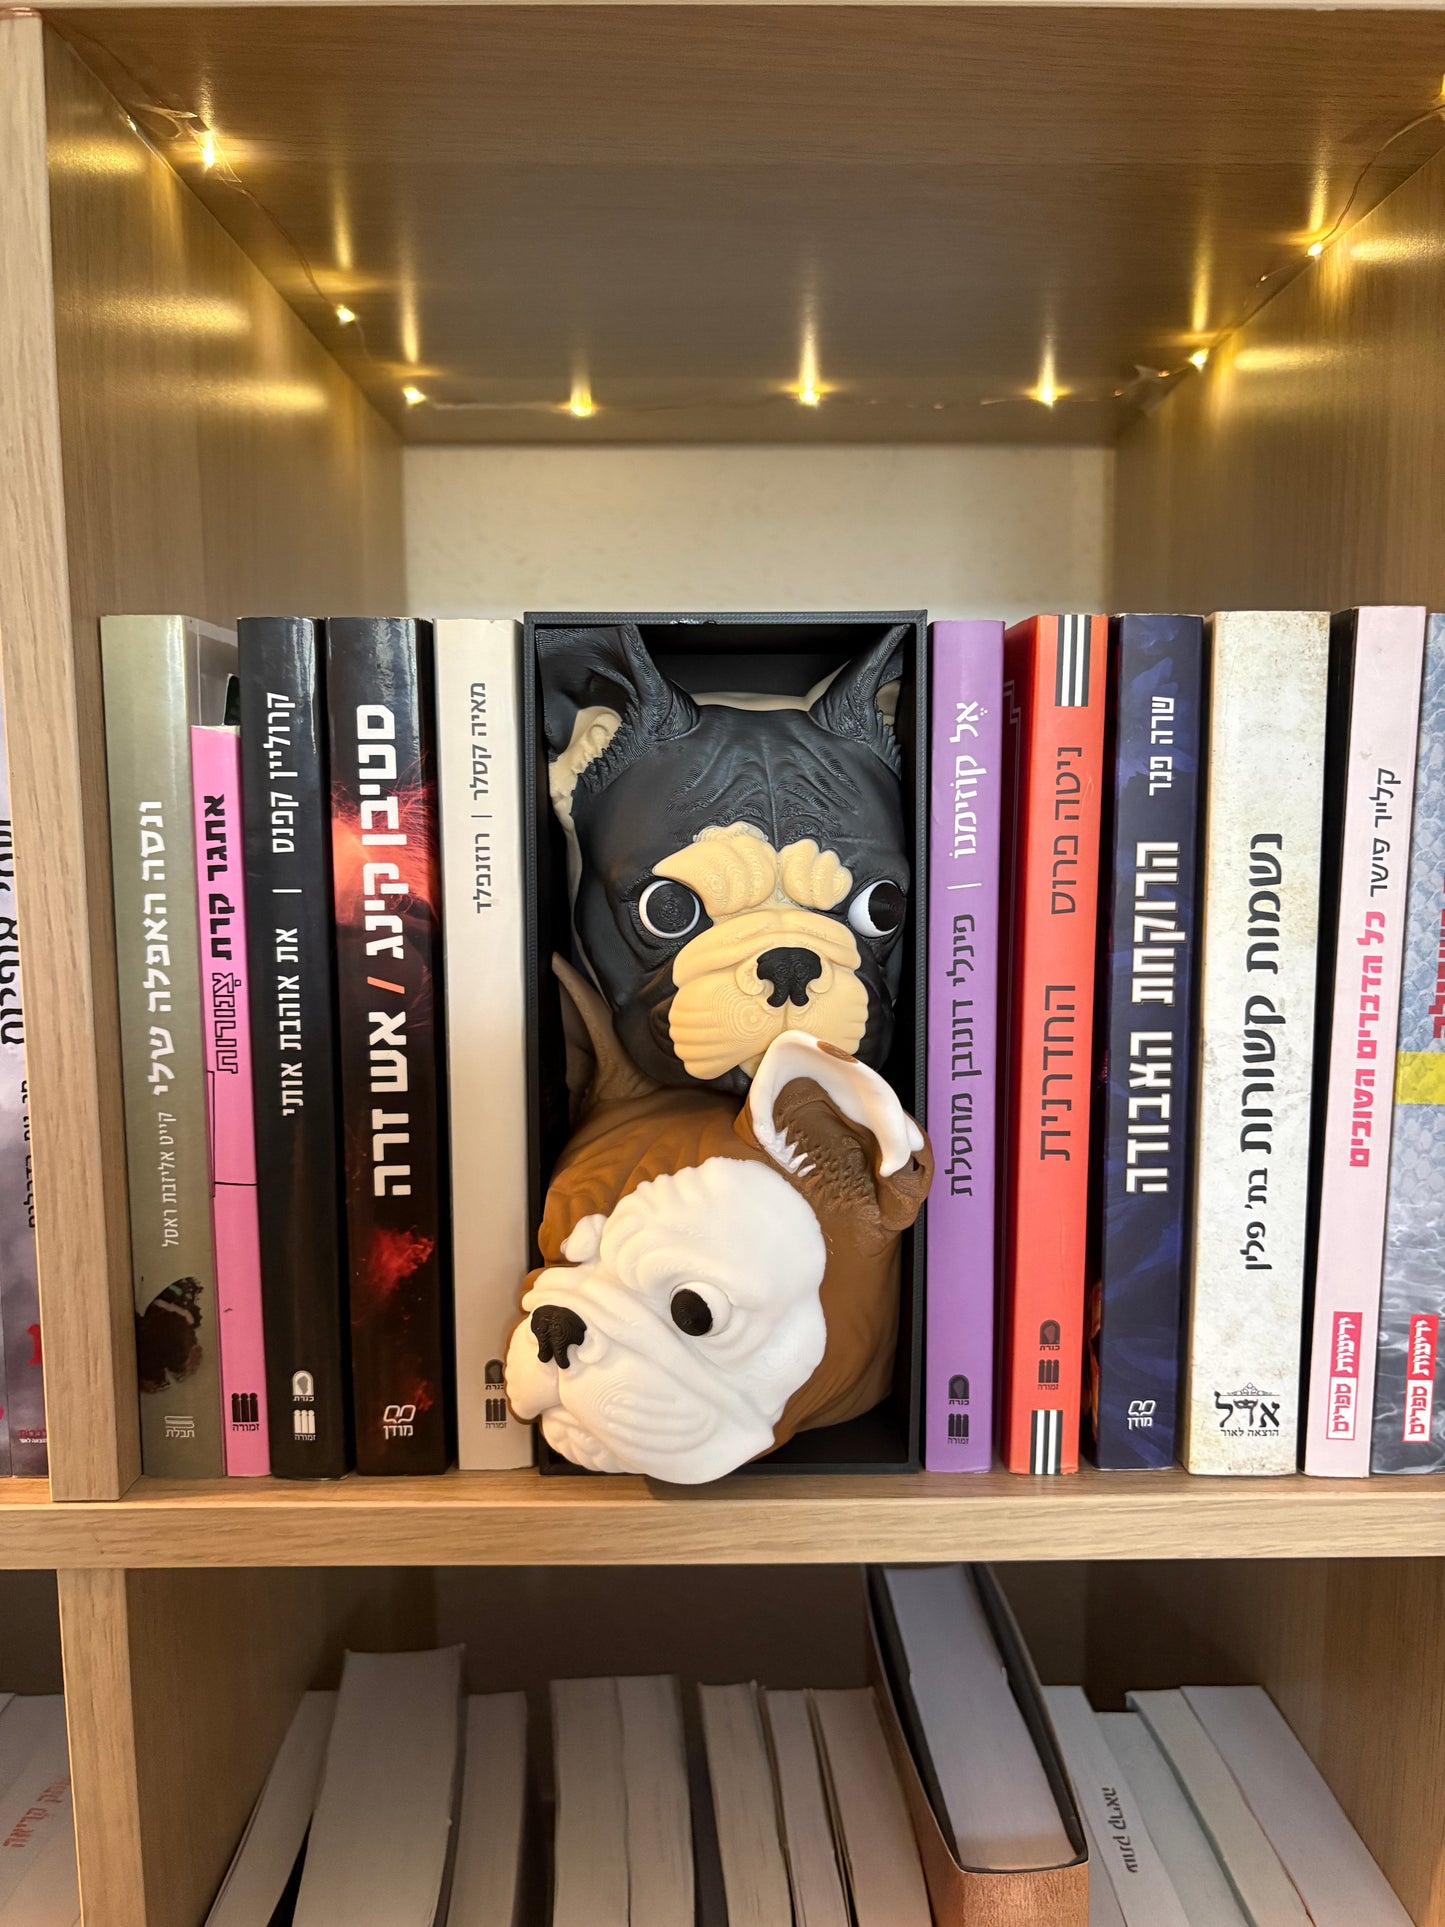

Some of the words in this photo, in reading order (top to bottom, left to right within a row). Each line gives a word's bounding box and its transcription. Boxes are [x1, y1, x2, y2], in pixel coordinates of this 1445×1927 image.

[263, 692, 298, 780] קרוליין
[470, 682, 487, 737] מאיה
[1150, 696, 1175, 745] שרה
[355, 704, 408, 847] סטיבן
[469, 743, 492, 801] קסלר
[1054, 746, 1083, 821] ניטה
[1148, 756, 1173, 796] פנר
[1369, 767, 1402, 829] קלייר
[139, 801, 166, 882] ונסה
[203, 794, 228, 882] אתגר
[270, 791, 299, 853] קפנס
[472, 833, 492, 914] רוזנפלד
[1051, 835, 1079, 915] פרוס
[1370, 837, 1391, 898] פישר
[208, 893, 235, 961] קרת
[361, 860, 410, 960] קינג
[1131, 842, 1186, 1004] הרוקחת
[1246, 833, 1283, 975] נשמות
[1356, 911, 1386, 946] כל
[142, 893, 172, 1013] האפלה
[275, 928, 299, 963] את
[945, 914, 975, 986] פינלי
[277, 975, 302, 1051] אוהבת
[951, 999, 983, 1081] דונובן
[1356, 955, 1383, 1060] הדברים
[147, 1025, 175, 1096] שלי
[368, 1011, 408, 1093] אש
[1040, 985, 1076, 1162] החדרנית
[1240, 995, 1286, 1155] קשורות
[280, 1062, 304, 1116] אותי
[1126, 1031, 1173, 1193] האבודה
[1349, 1068, 1376, 1168] הטובים
[158, 1111, 177, 1145] קייט
[371, 1108, 412, 1197] זרה
[944, 1092, 973, 1197] מחסלת
[158, 1151, 177, 1204] אליזבת
[162, 1209, 179, 1247] ראסל
[1239, 1221, 1273, 1270] פלין
[1335, 1316, 1356, 1374] ידיעות
[1412, 1319, 1431, 1376] ידיעות
[383, 1425, 413, 1440] מודן
[1127, 1417, 1152, 1430] מודן
[1221, 1428, 1244, 1437] לאור
[1332, 1383, 1352, 1433] ספרים
[1409, 1385, 1428, 1435] ספרים
[1101, 1787, 1127, 1830] קריאה
[1113, 1836, 1138, 1873] עותק
